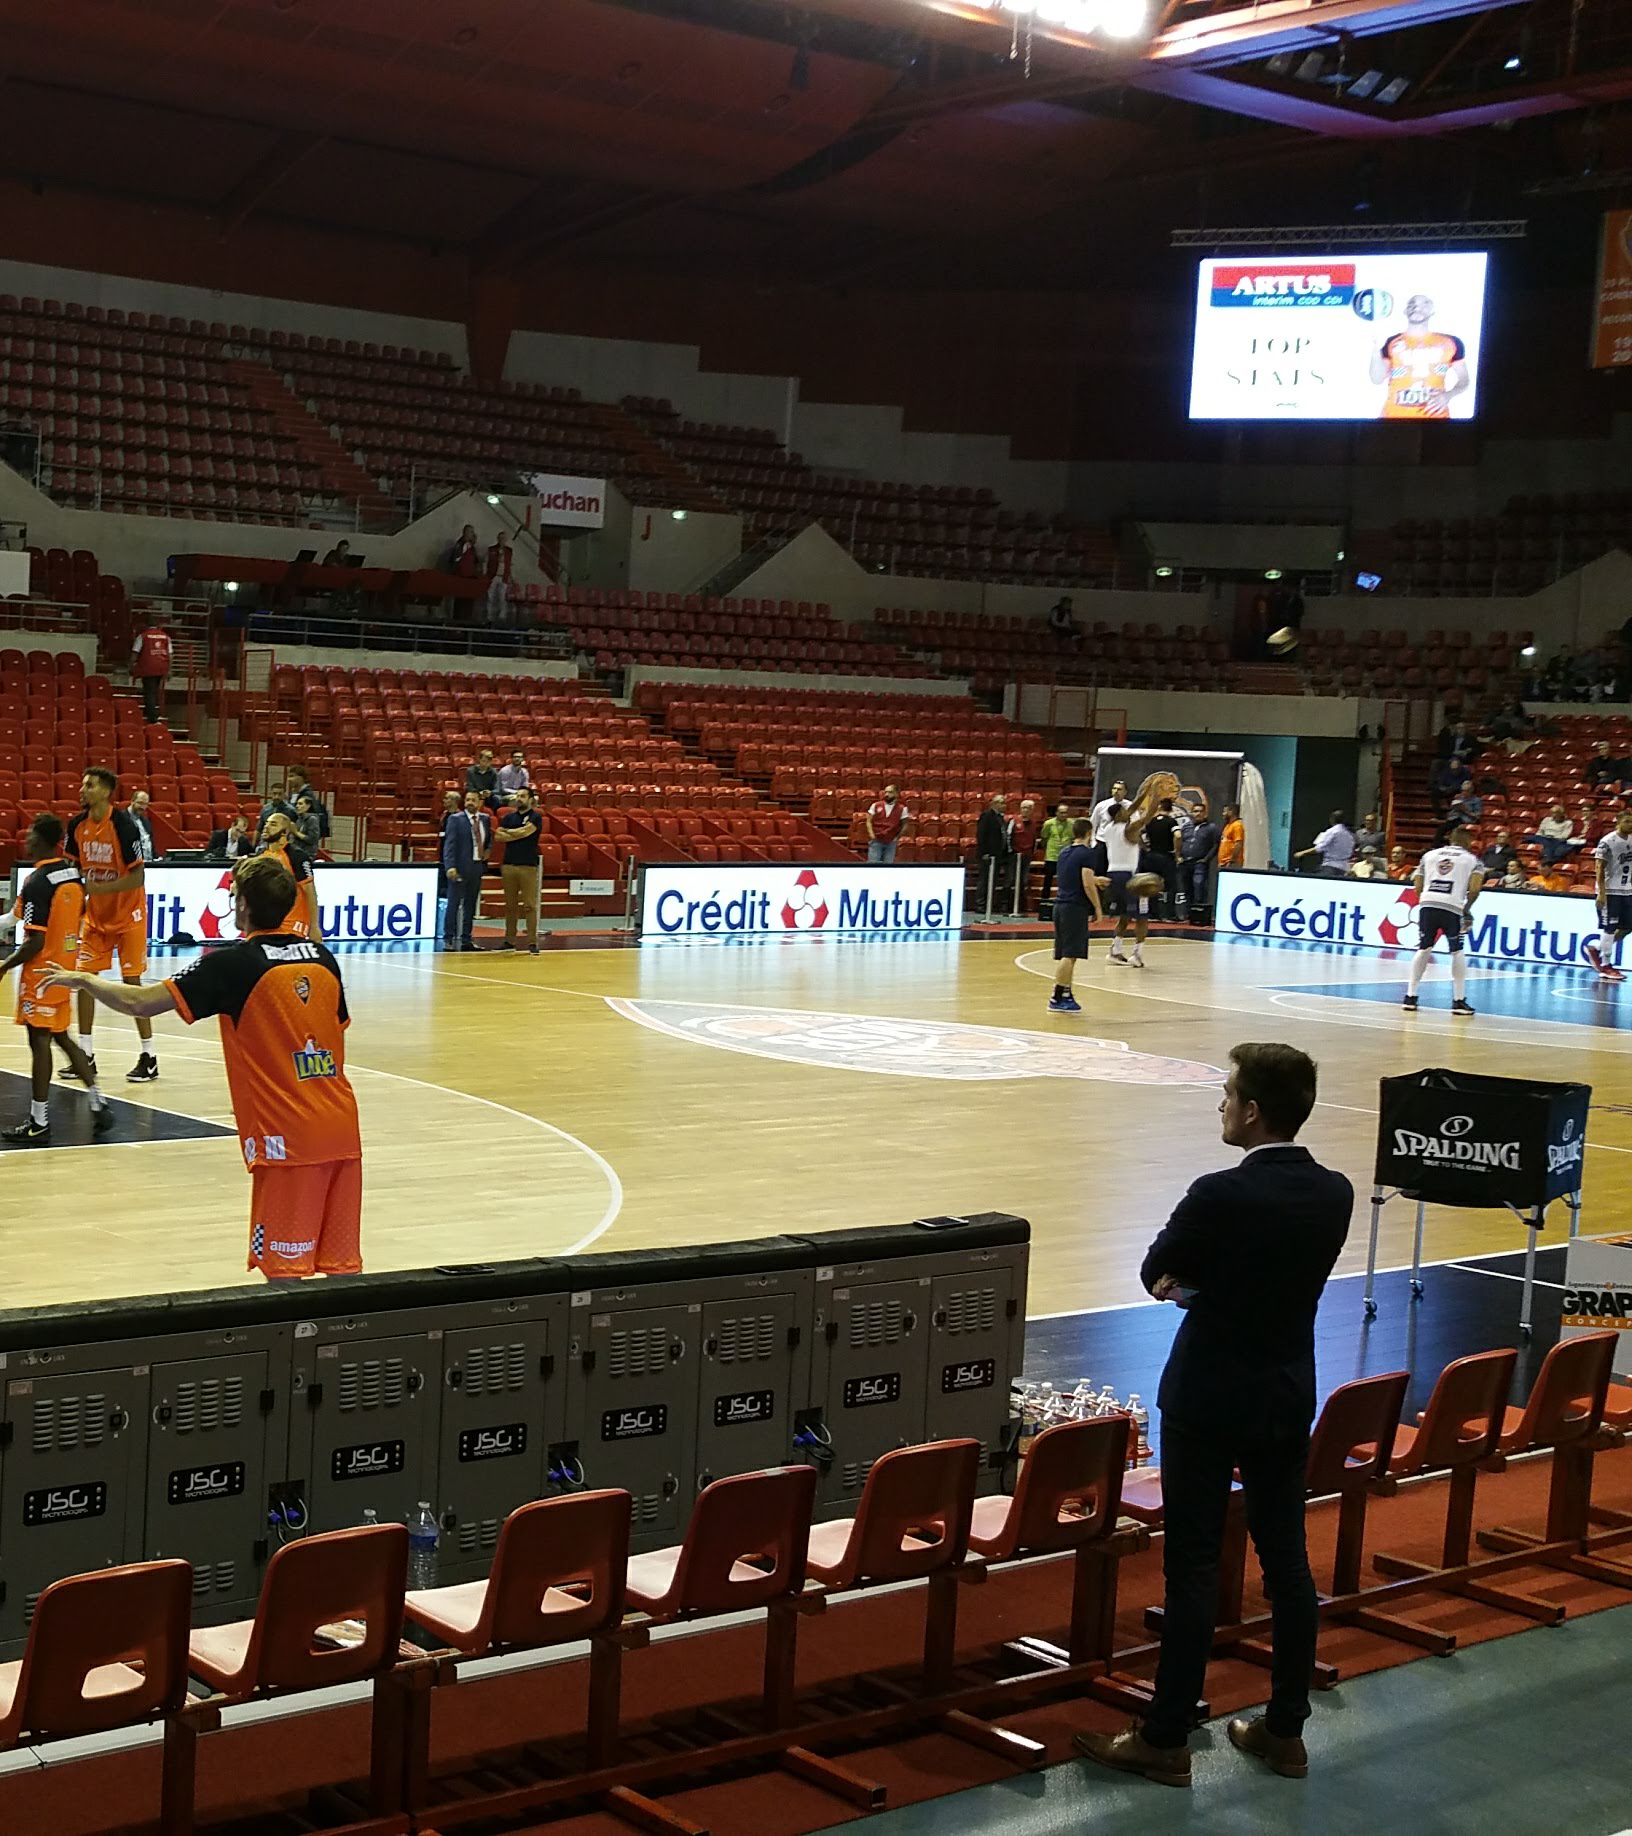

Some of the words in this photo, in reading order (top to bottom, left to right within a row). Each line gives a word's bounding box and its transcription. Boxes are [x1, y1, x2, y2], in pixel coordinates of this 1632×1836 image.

[1231, 275, 1332, 295] ARTUS
[1249, 338, 1310, 354] TOP
[1227, 369, 1325, 386] STATS
[538, 491, 599, 513] uchan
[319, 892, 424, 938] utuel
[657, 889, 770, 932] Crédit
[838, 889, 952, 929] Mutuel
[1230, 892, 1366, 942] Crédit
[1392, 1128, 1522, 1172] SPALDING
